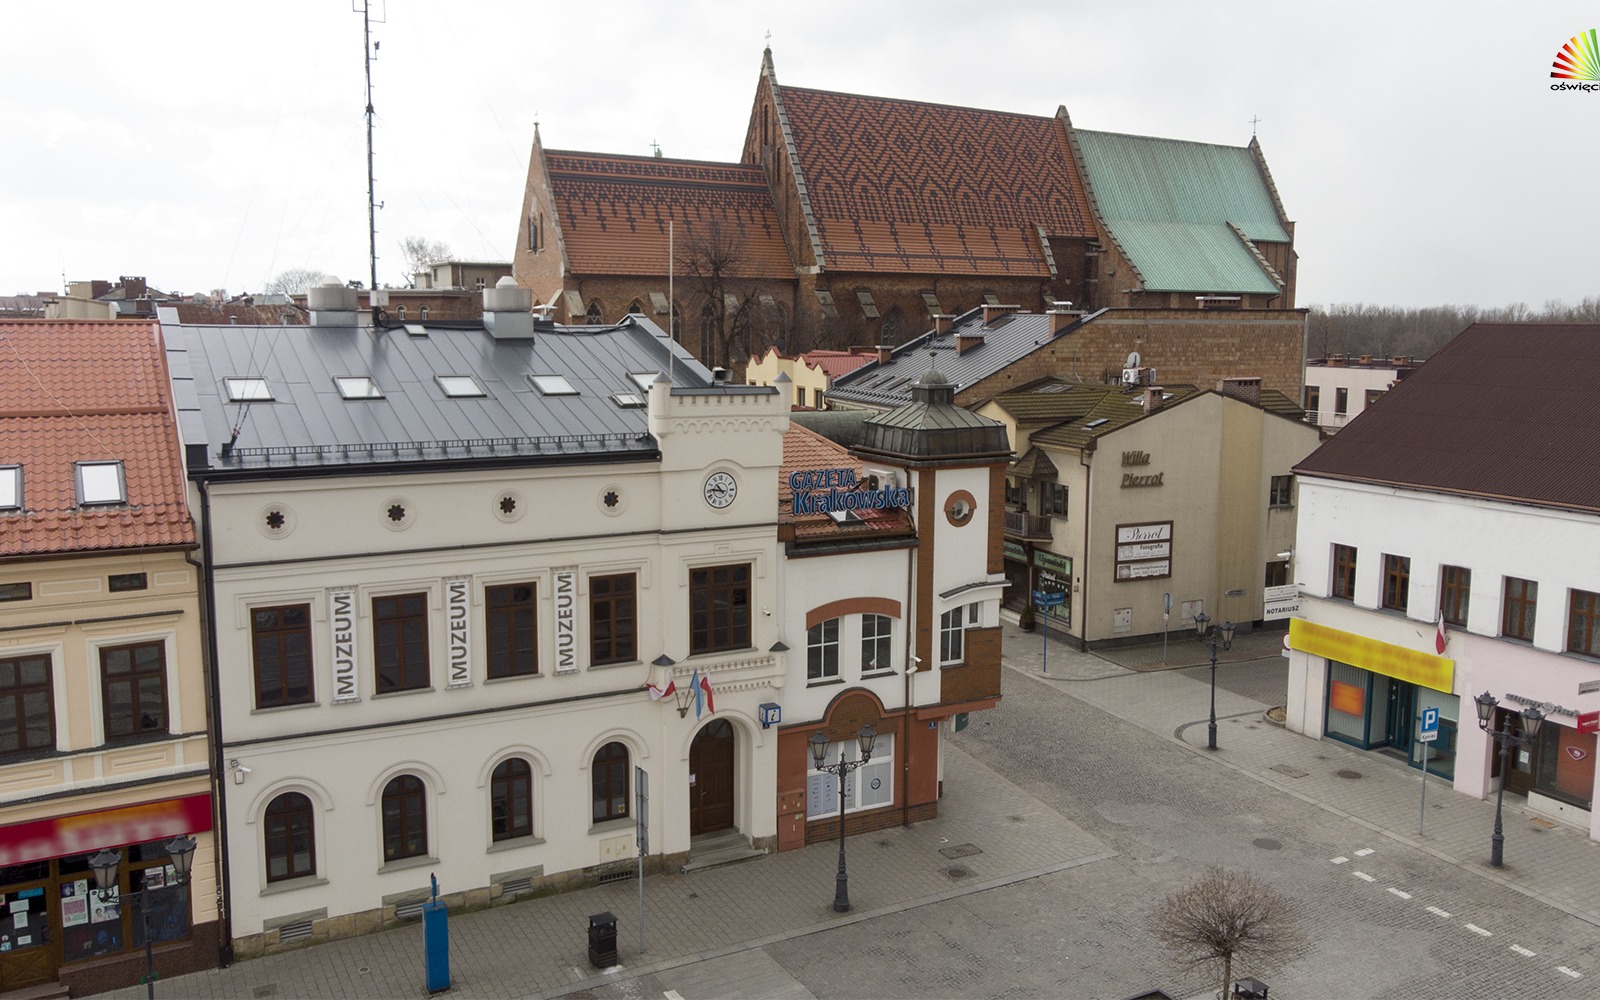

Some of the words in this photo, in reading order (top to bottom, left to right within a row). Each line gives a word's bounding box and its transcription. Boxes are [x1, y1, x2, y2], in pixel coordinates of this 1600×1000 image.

[1121, 450, 1151, 467] Willa
[789, 468, 857, 490] GAZETA
[1121, 471, 1164, 489] Pierrot
[792, 484, 909, 515] Krakowska
[1139, 543, 1163, 551] Fotografia
[556, 574, 575, 667] MUZEUM
[1266, 605, 1300, 615] NOTARIUSZ
[449, 581, 468, 680] MUZEUM
[334, 593, 355, 696] MUZEUM
[1424, 710, 1436, 730] P
